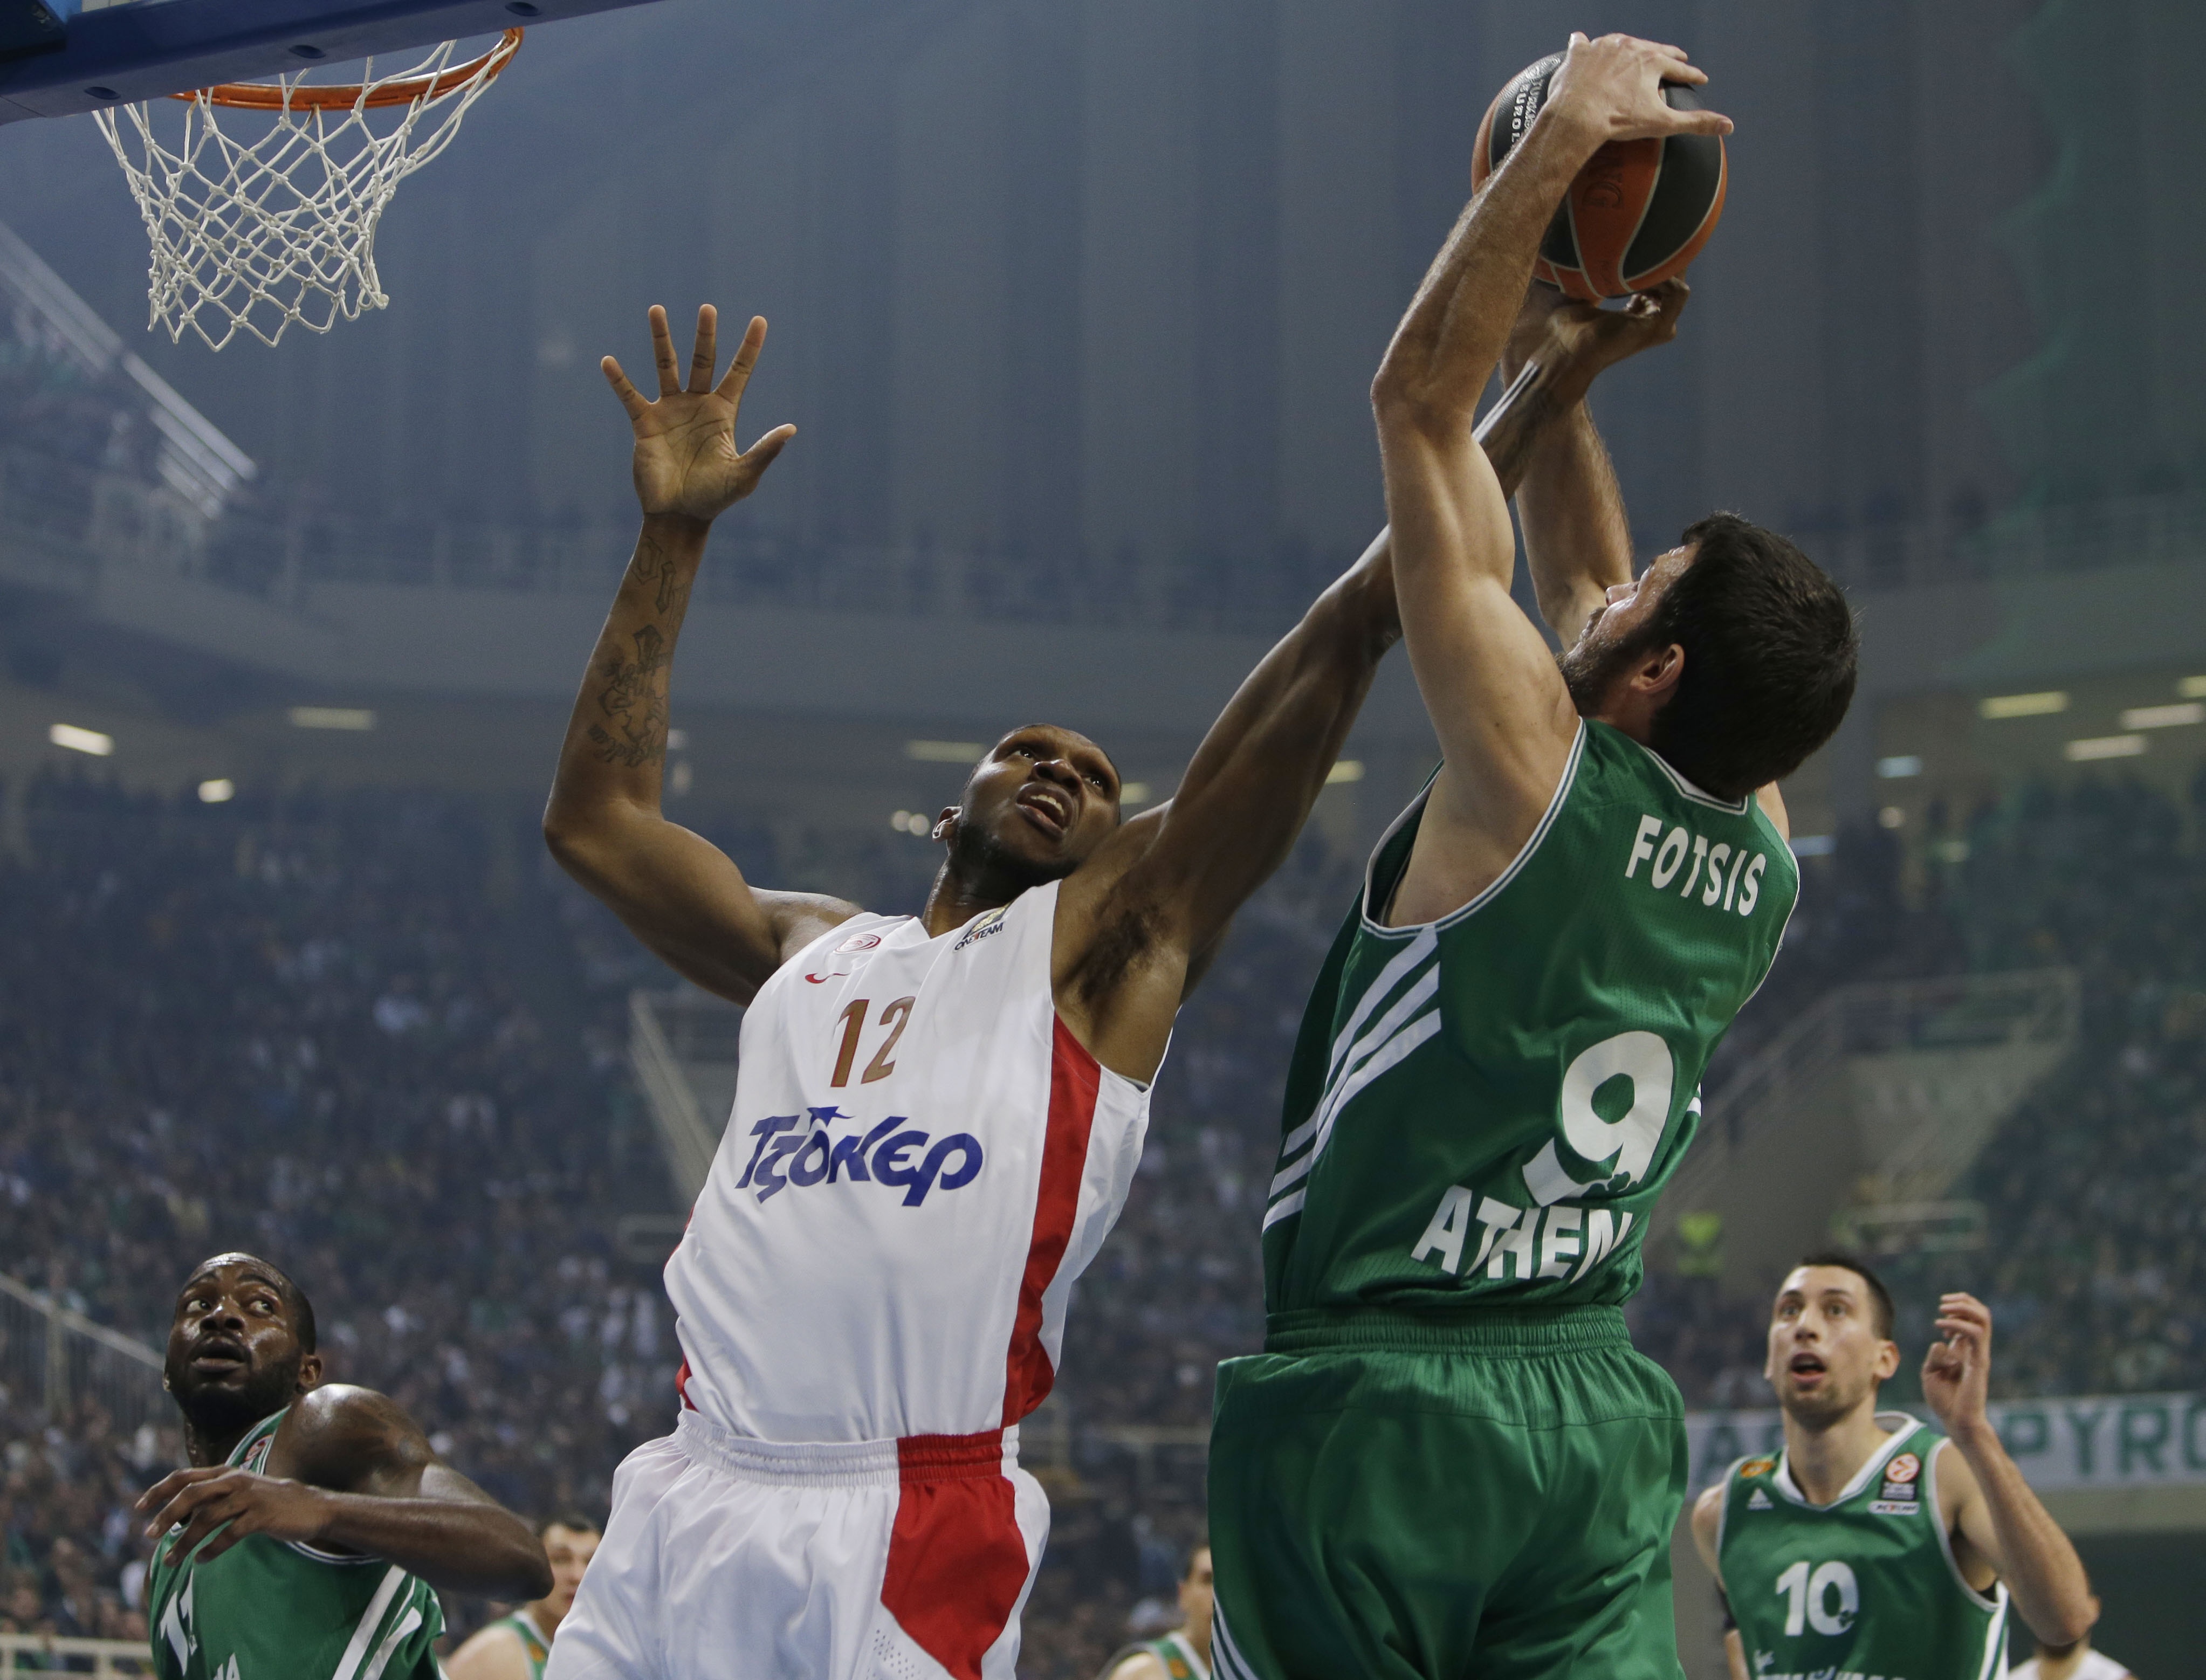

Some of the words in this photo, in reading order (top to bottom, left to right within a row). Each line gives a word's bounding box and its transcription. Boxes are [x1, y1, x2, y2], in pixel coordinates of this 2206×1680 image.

[1625, 814, 1766, 916] FOTSIS
[830, 996, 916, 1087] 12
[1522, 1030, 1674, 1207] 9
[1776, 1561, 1859, 1636] 10
